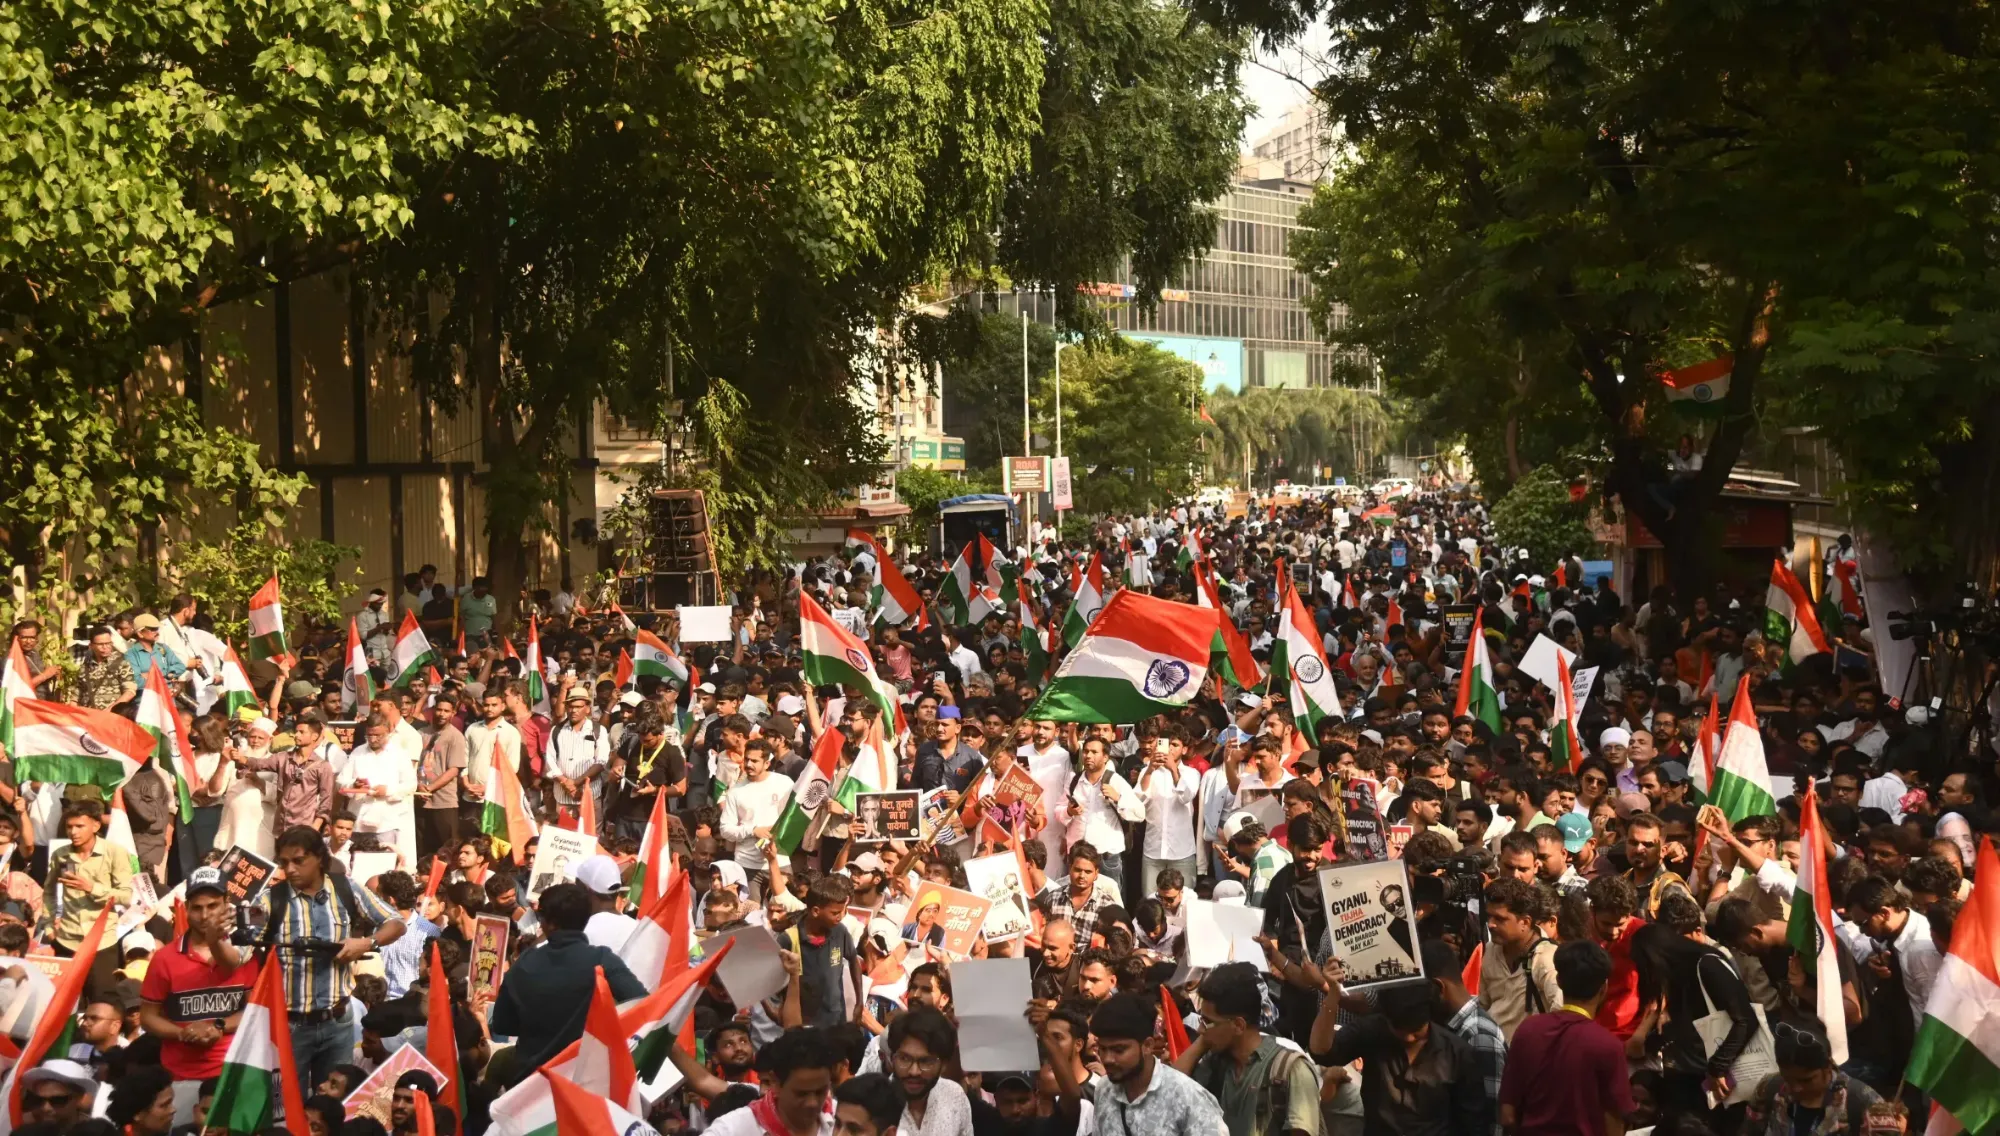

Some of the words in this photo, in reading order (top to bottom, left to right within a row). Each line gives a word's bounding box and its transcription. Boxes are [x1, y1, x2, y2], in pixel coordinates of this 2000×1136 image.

[881, 799, 895, 809] बेटा,
[895, 798, 914, 811] तुमसे
[889, 811, 898, 820] ना
[899, 810, 907, 820] हो
[886, 821, 909, 831] पायेगा!
[554, 836, 581, 847] Gyanesh
[1331, 891, 1371, 916] GYANU,
[1340, 907, 1364, 922] TUJHA
[1334, 912, 1387, 941] DEMOCRACY
[1343, 937, 1354, 947] VAR
[1354, 929, 1379, 943] BHAROSA
[1350, 943, 1362, 952] NAY
[1362, 938, 1374, 949] KA?
[180, 991, 243, 1016] TOMMY
